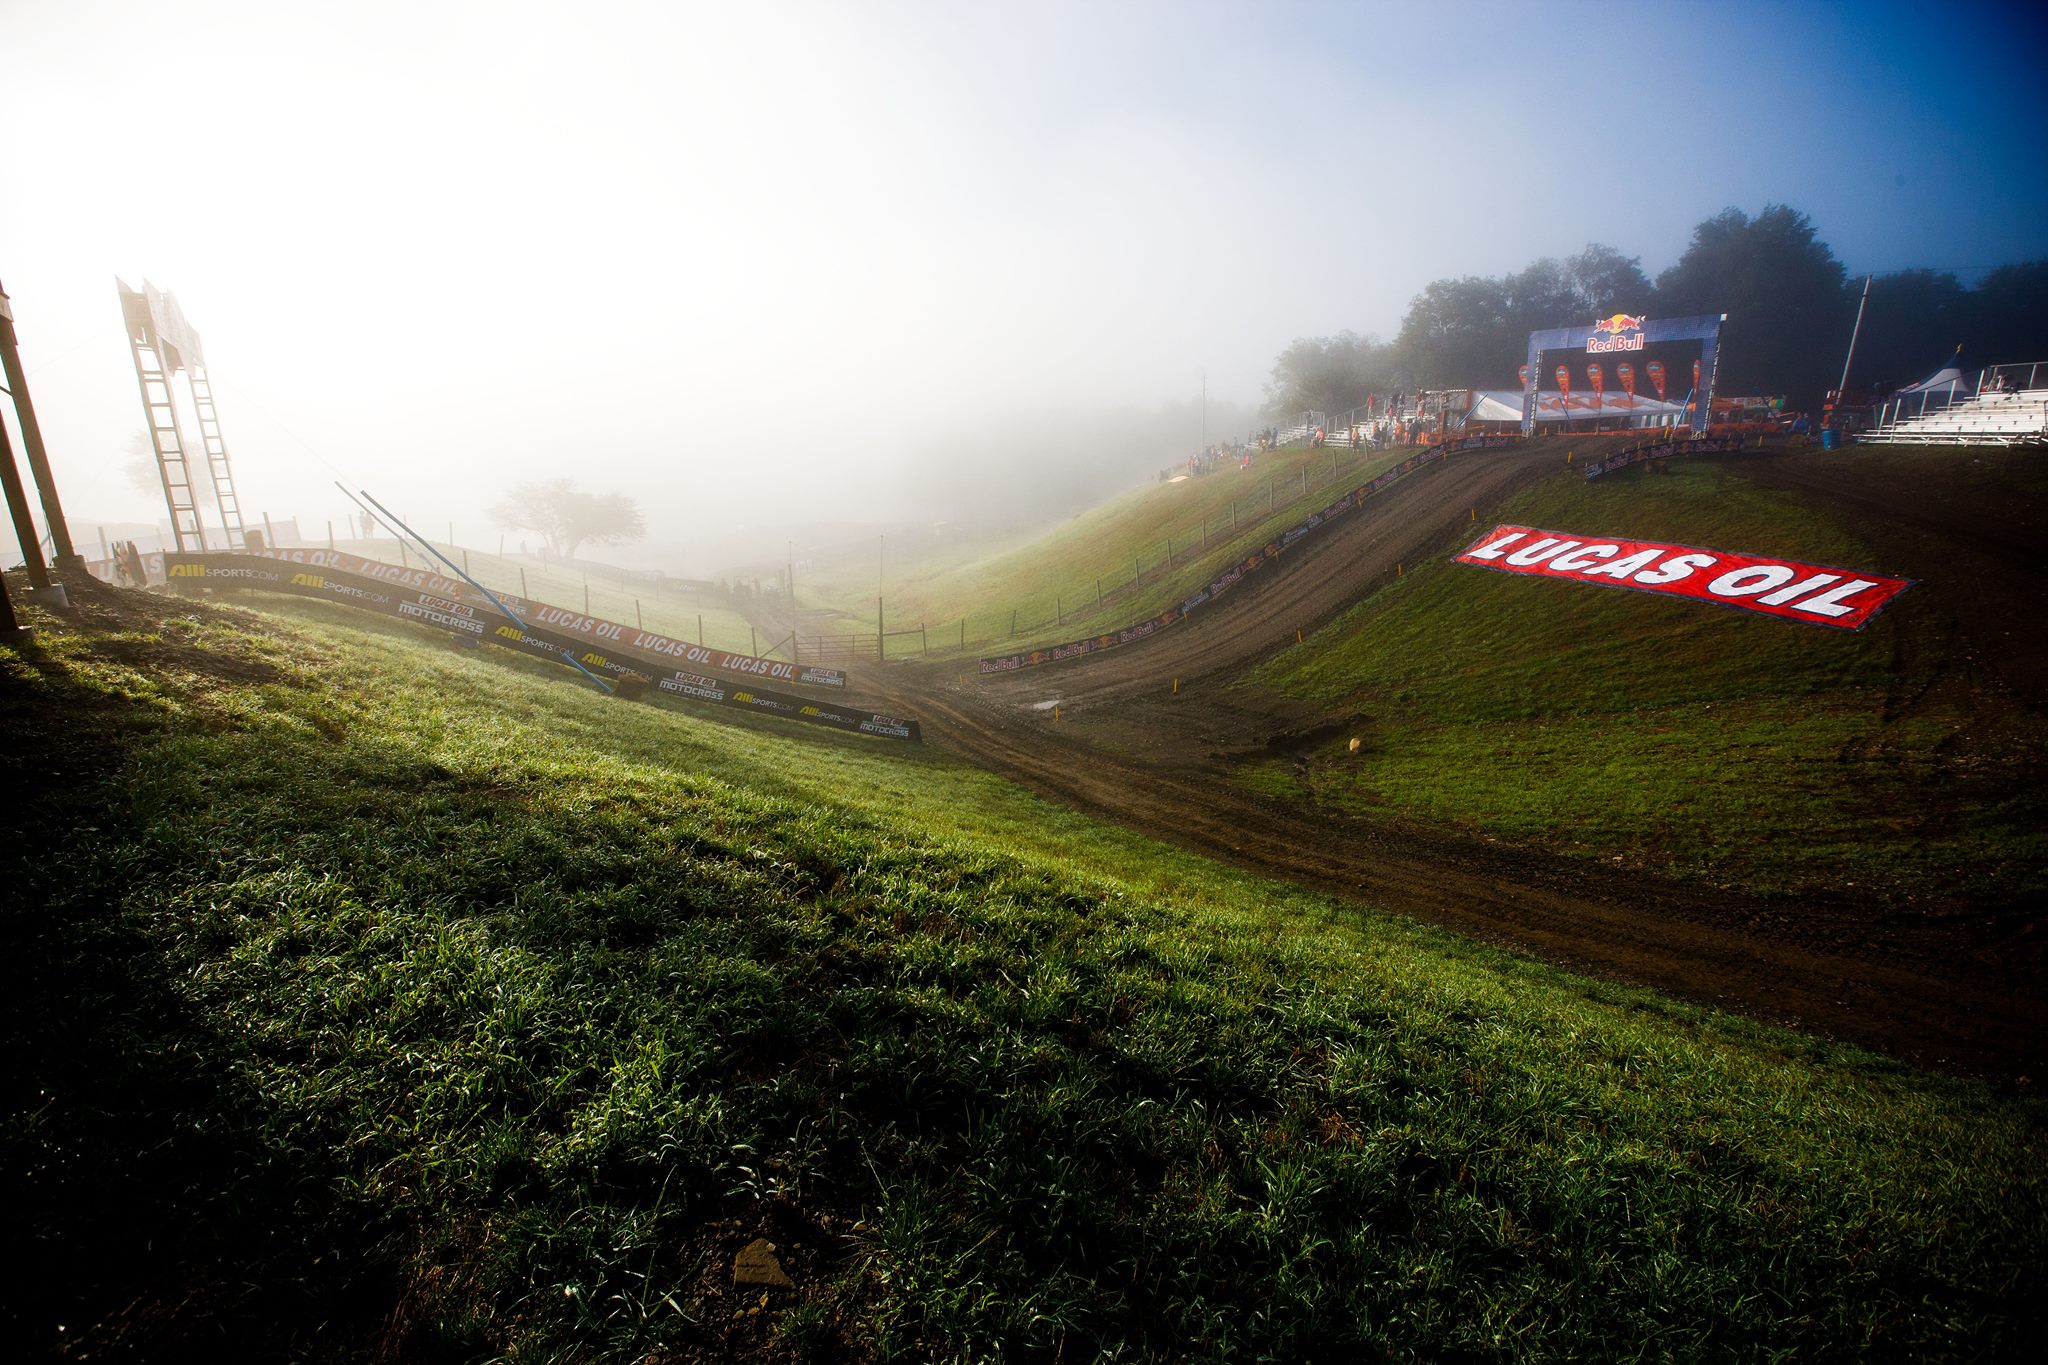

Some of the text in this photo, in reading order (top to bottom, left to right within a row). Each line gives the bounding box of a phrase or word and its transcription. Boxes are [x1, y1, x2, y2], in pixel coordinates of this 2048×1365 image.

[1586, 333, 1644, 353] Red Bull
[359, 562, 425, 587] LUCAS
[1467, 532, 1879, 617] LUCAS OIL
[419, 595, 474, 617] LUCAS OIL
[399, 604, 485, 634] MOTOCROSS
[536, 607, 595, 633] LUCAS
[596, 622, 623, 640] OIL
[633, 633, 712, 664] LUCAS OIL
[721, 654, 793, 679] LUCAS OIL
[981, 656, 1020, 673] Red Bull
[660, 680, 725, 700] MOTOCROSS
[677, 672, 715, 688] LUCAS OIL
[801, 674, 843, 686] MOTOCROSS
[860, 723, 909, 737] MOTOCROSS
